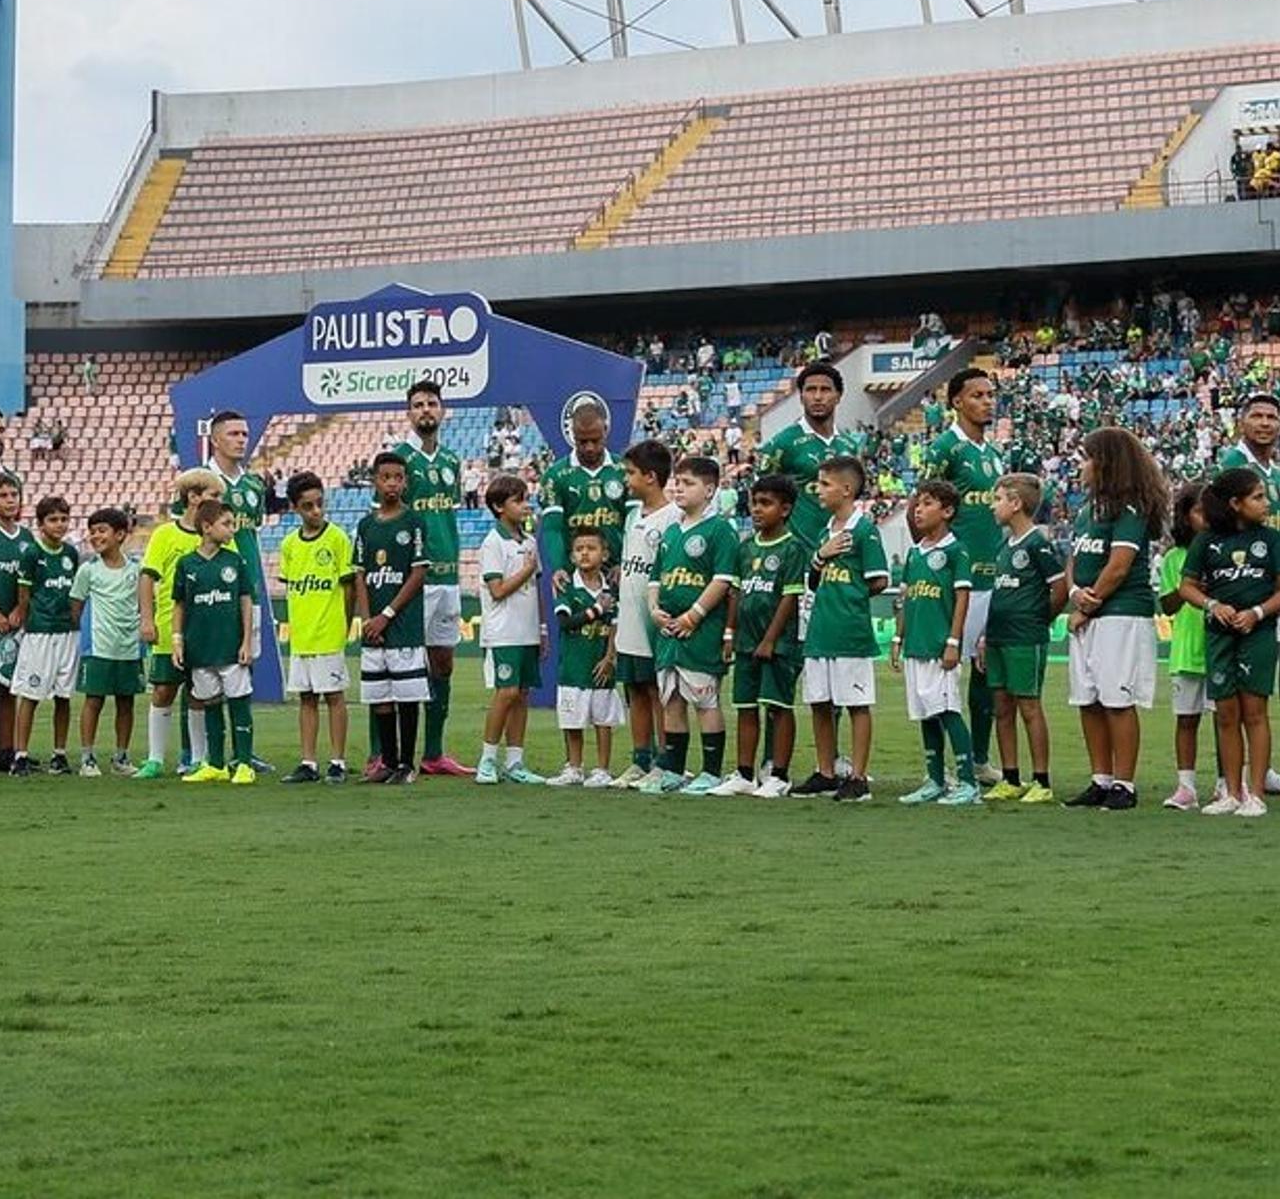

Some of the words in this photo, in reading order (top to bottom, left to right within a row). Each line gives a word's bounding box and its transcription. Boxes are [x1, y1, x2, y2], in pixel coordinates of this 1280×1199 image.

[346, 368, 418, 392] Sicredi
[421, 366, 470, 389] 2024
[287, 573, 332, 596] refisa
[366, 566, 404, 589] refisa
[194, 590, 231, 605] crefisa
